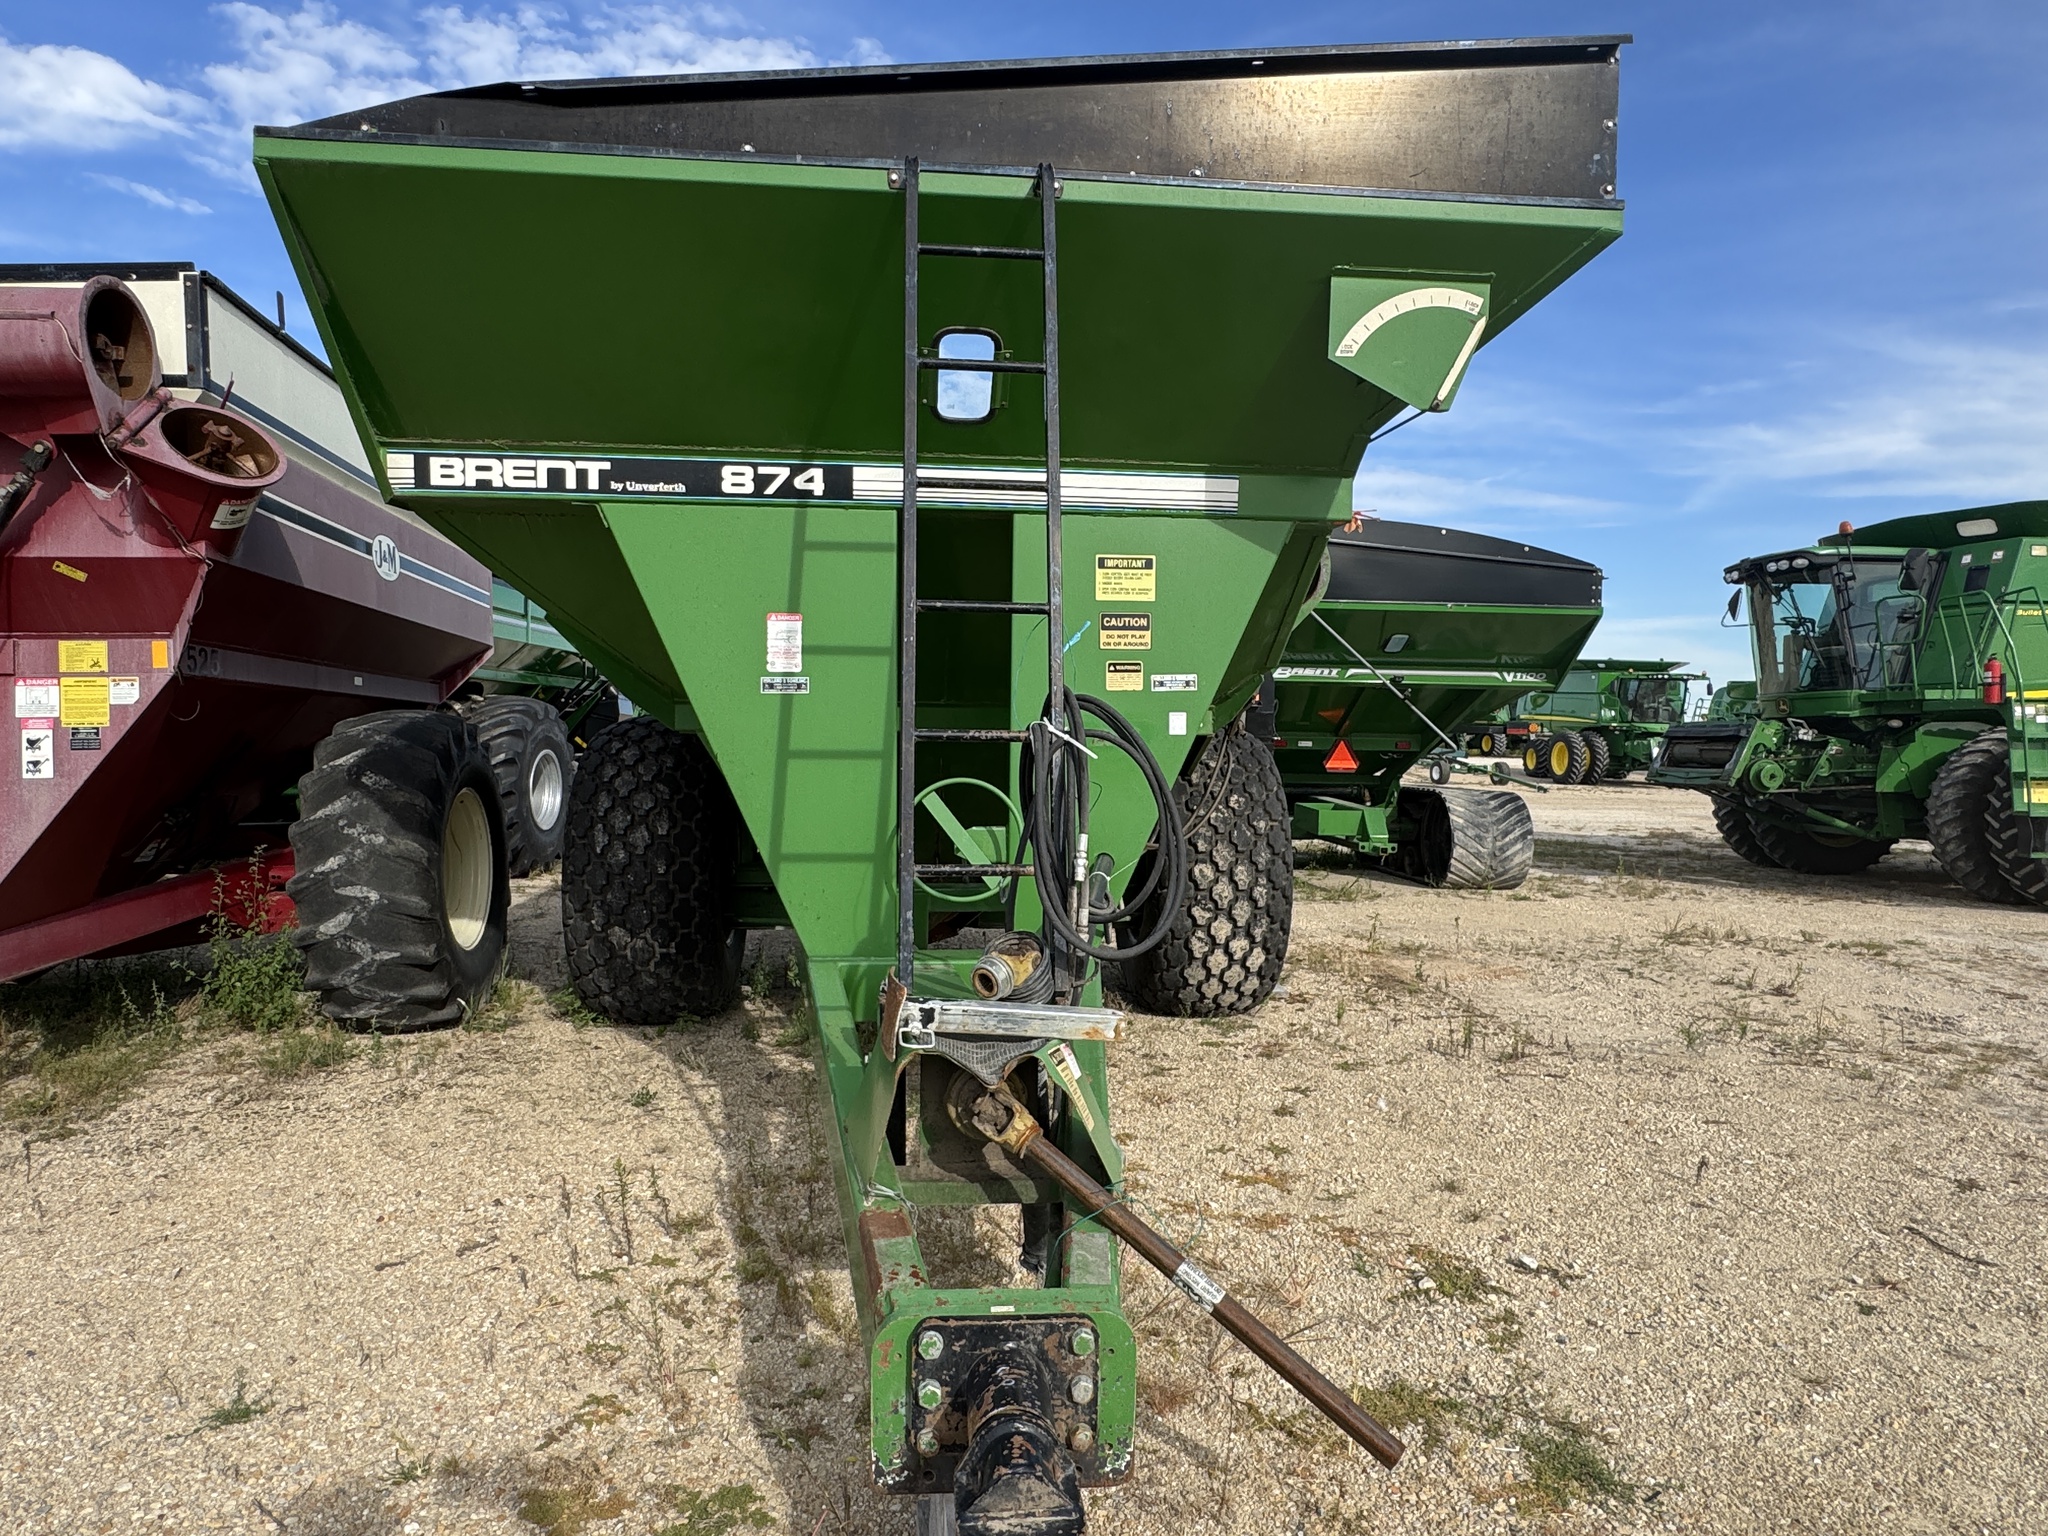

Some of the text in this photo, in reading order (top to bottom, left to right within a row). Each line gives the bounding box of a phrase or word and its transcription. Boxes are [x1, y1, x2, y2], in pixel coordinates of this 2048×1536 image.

[429, 456, 825, 496] BRENT by Unverferth 874
[374, 540, 397, 574] J&M
[1104, 558, 1147, 568] IMPORTANT
[1103, 617, 1148, 627] CAUTION
[1272, 666, 1341, 678] BRENT
